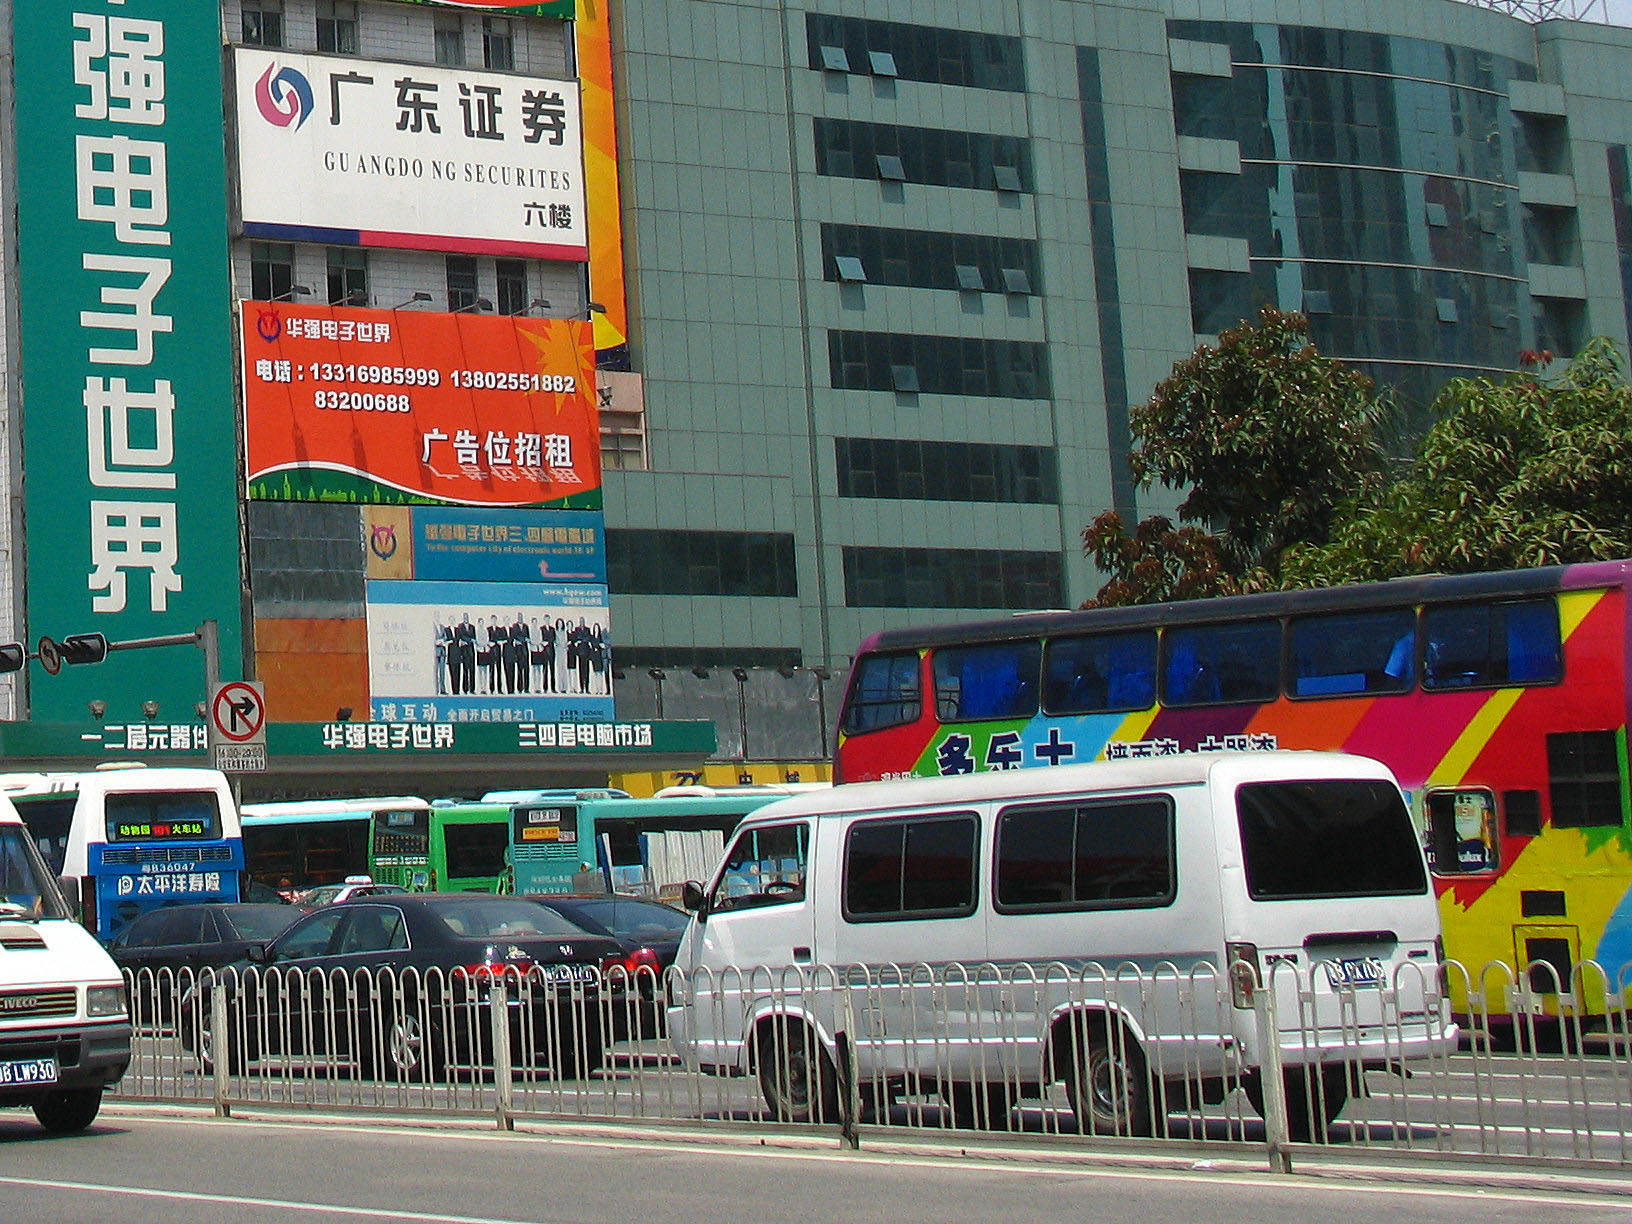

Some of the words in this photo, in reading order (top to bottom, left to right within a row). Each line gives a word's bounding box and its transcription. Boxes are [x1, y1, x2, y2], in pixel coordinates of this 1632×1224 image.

[329, 71, 567, 146] 广东证券
[522, 201, 573, 230] 六楼
[285, 317, 391, 344] 华强电子世界
[450, 370, 576, 394] 13802551882
[314, 390, 411, 413] 83200688
[421, 427, 574, 469] 广告位招租
[322, 723, 455, 750] 华强电子世界
[518, 724, 654, 748] 三四层电脑市场
[172, 823, 202, 835] 火车站
[137, 872, 220, 894] 太平洋寿险
[3, 997, 38, 1010] IVECO
